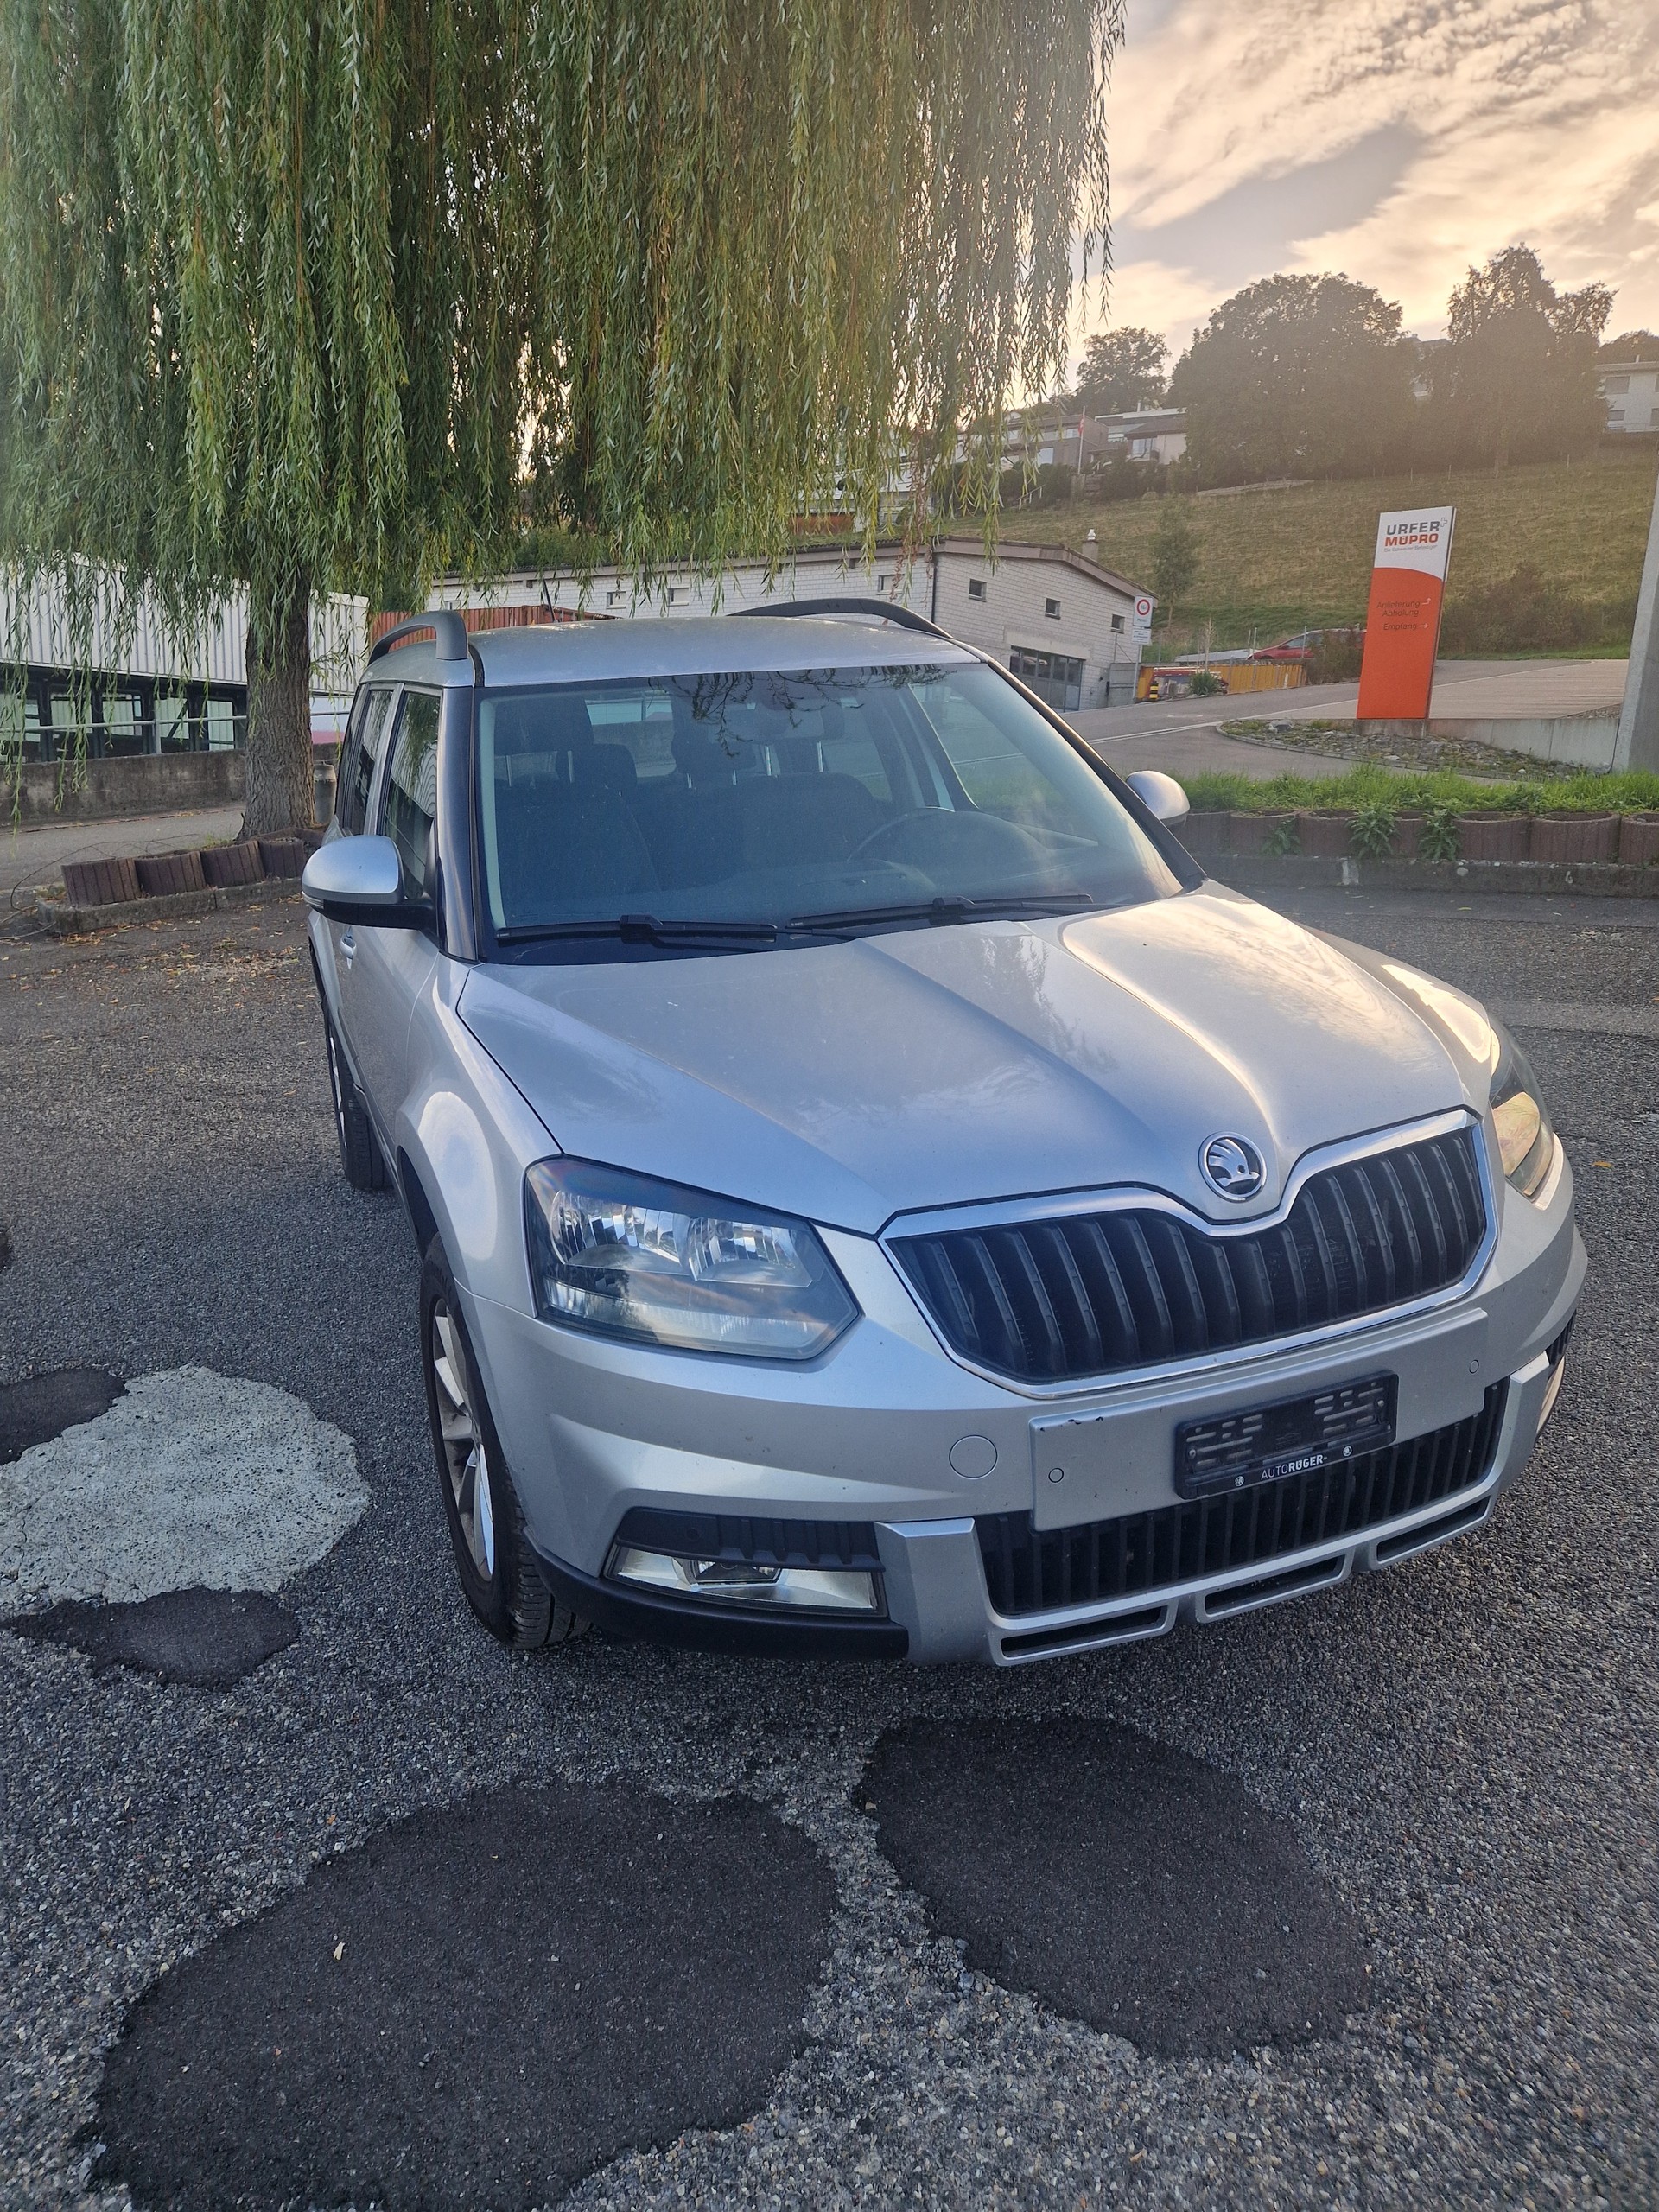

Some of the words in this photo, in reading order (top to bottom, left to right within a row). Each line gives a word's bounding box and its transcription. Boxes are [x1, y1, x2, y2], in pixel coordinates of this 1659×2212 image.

[1387, 521, 1440, 535] URFER
[1385, 533, 1439, 546] MÜPRO
[1383, 622, 1417, 631] Empfang
[1261, 1454, 1324, 1480] AUTORÜGER
